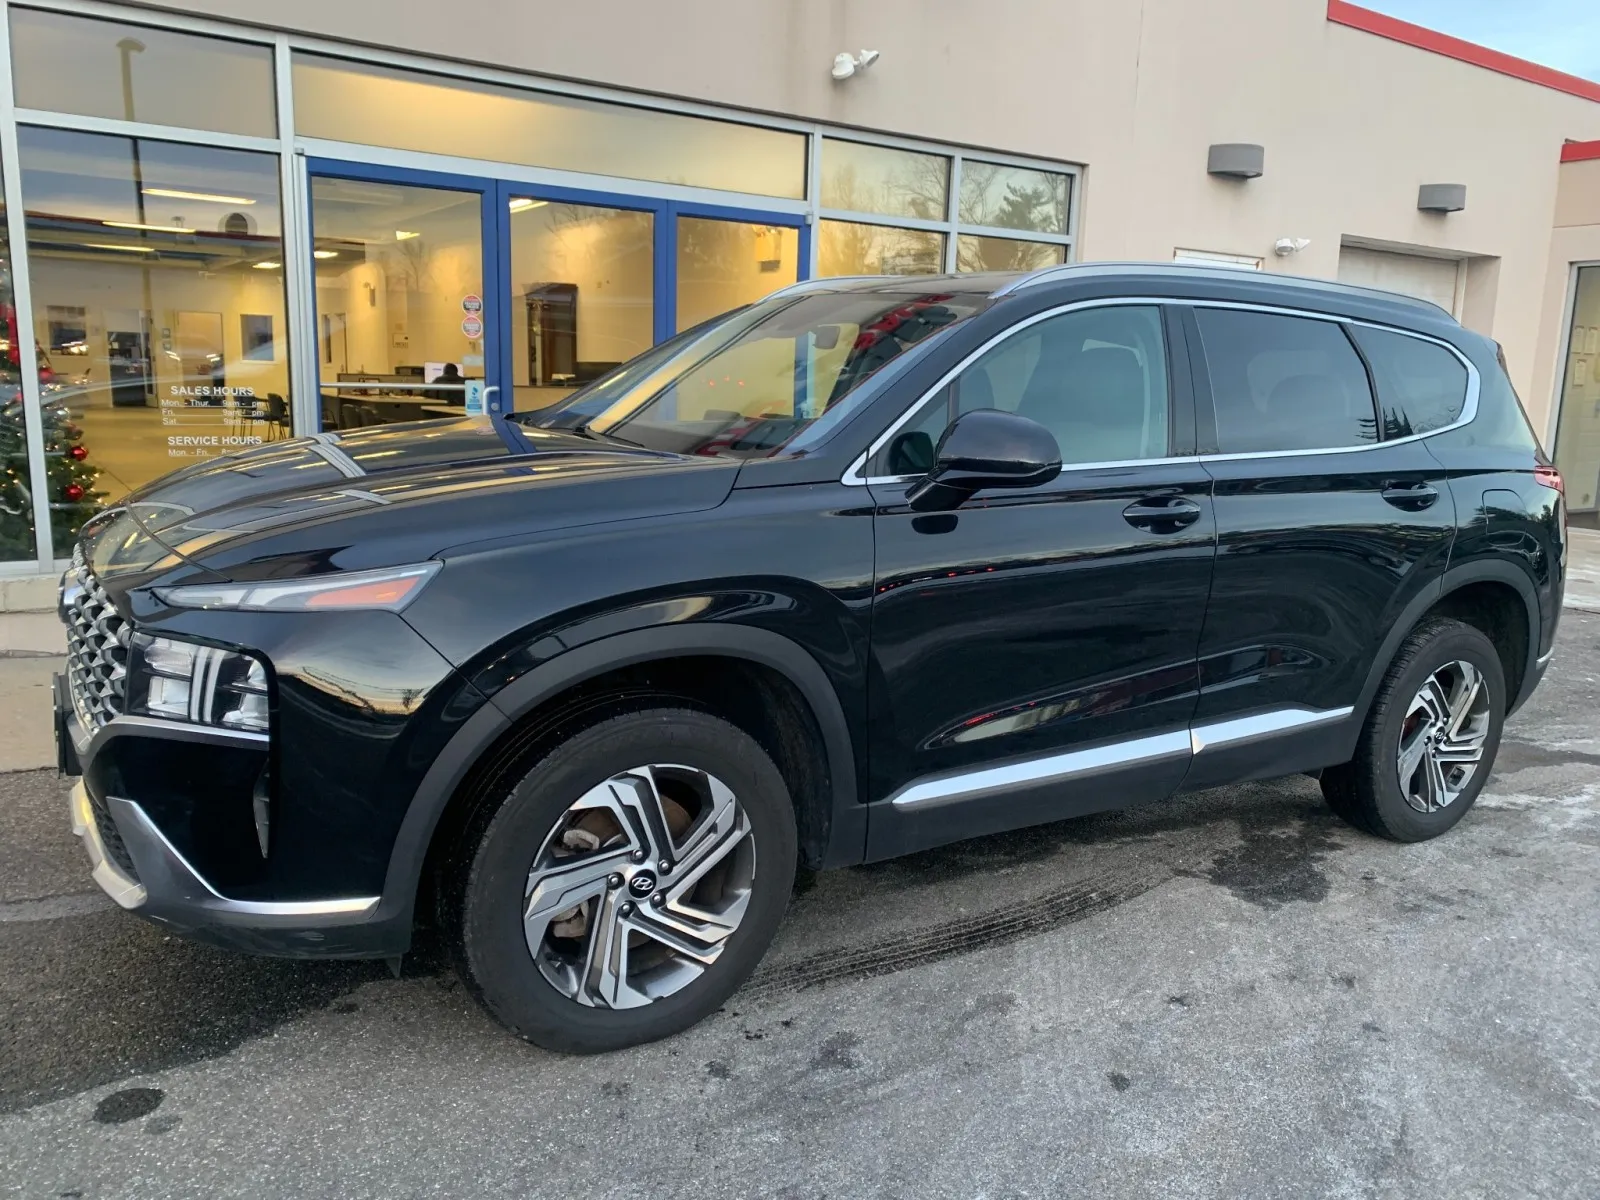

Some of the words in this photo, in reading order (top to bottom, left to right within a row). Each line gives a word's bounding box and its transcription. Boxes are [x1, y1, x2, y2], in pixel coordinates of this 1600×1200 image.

[170, 385, 210, 395] SALES
[213, 386, 254, 396] HOURS
[167, 436, 218, 445] SERVICE
[221, 436, 262, 445] HOURS
